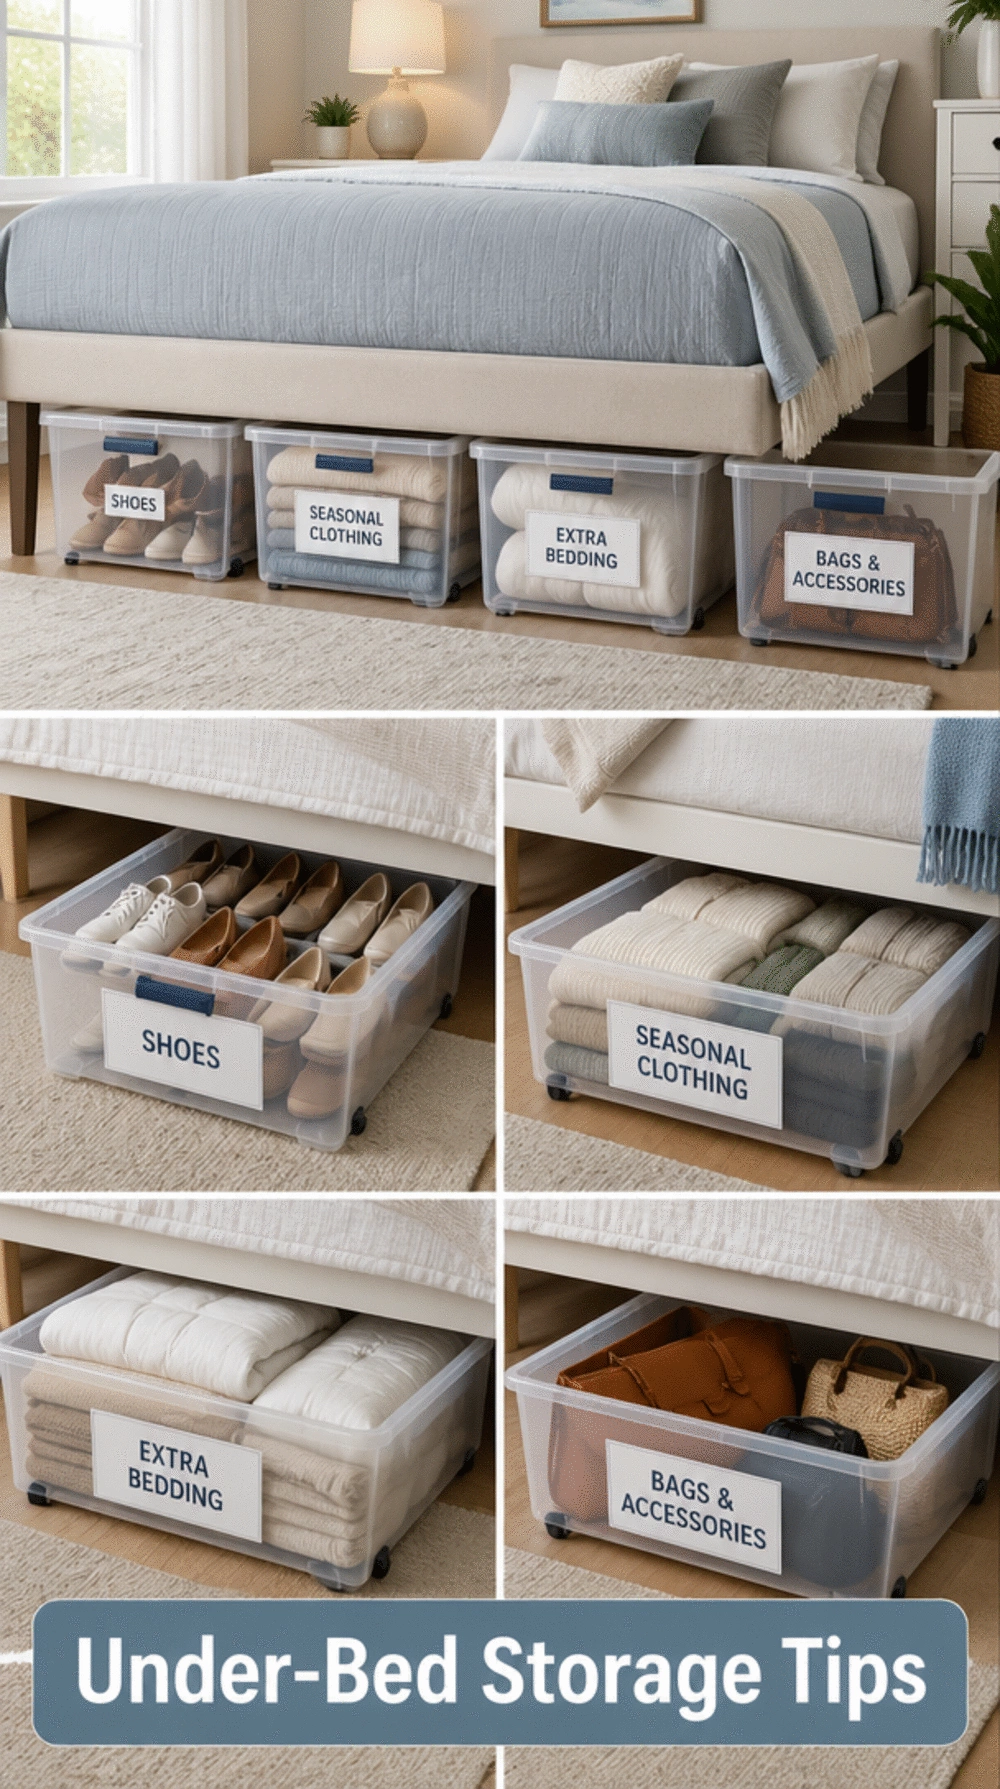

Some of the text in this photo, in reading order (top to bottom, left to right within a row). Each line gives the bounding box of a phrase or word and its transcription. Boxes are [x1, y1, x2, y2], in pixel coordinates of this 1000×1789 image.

[111, 493, 157, 513] SHOES
[309, 505, 384, 527] SEASONAL
[309, 525, 383, 547] CLOTHING
[556, 527, 608, 547] EXTRA
[546, 547, 618, 570] BEDDING
[816, 549, 881, 572] BAGS &
[792, 570, 906, 598] ACCESSORIES
[142, 1029, 221, 1070] SHOES
[636, 1024, 752, 1072] SEASONAL
[637, 1055, 749, 1101] CLOTHING
[139, 1439, 210, 1479] EXTRA
[128, 1466, 223, 1512] BEDDING
[651, 1469, 735, 1512] BAGS &
[621, 1492, 767, 1551] ACCESSORIES
